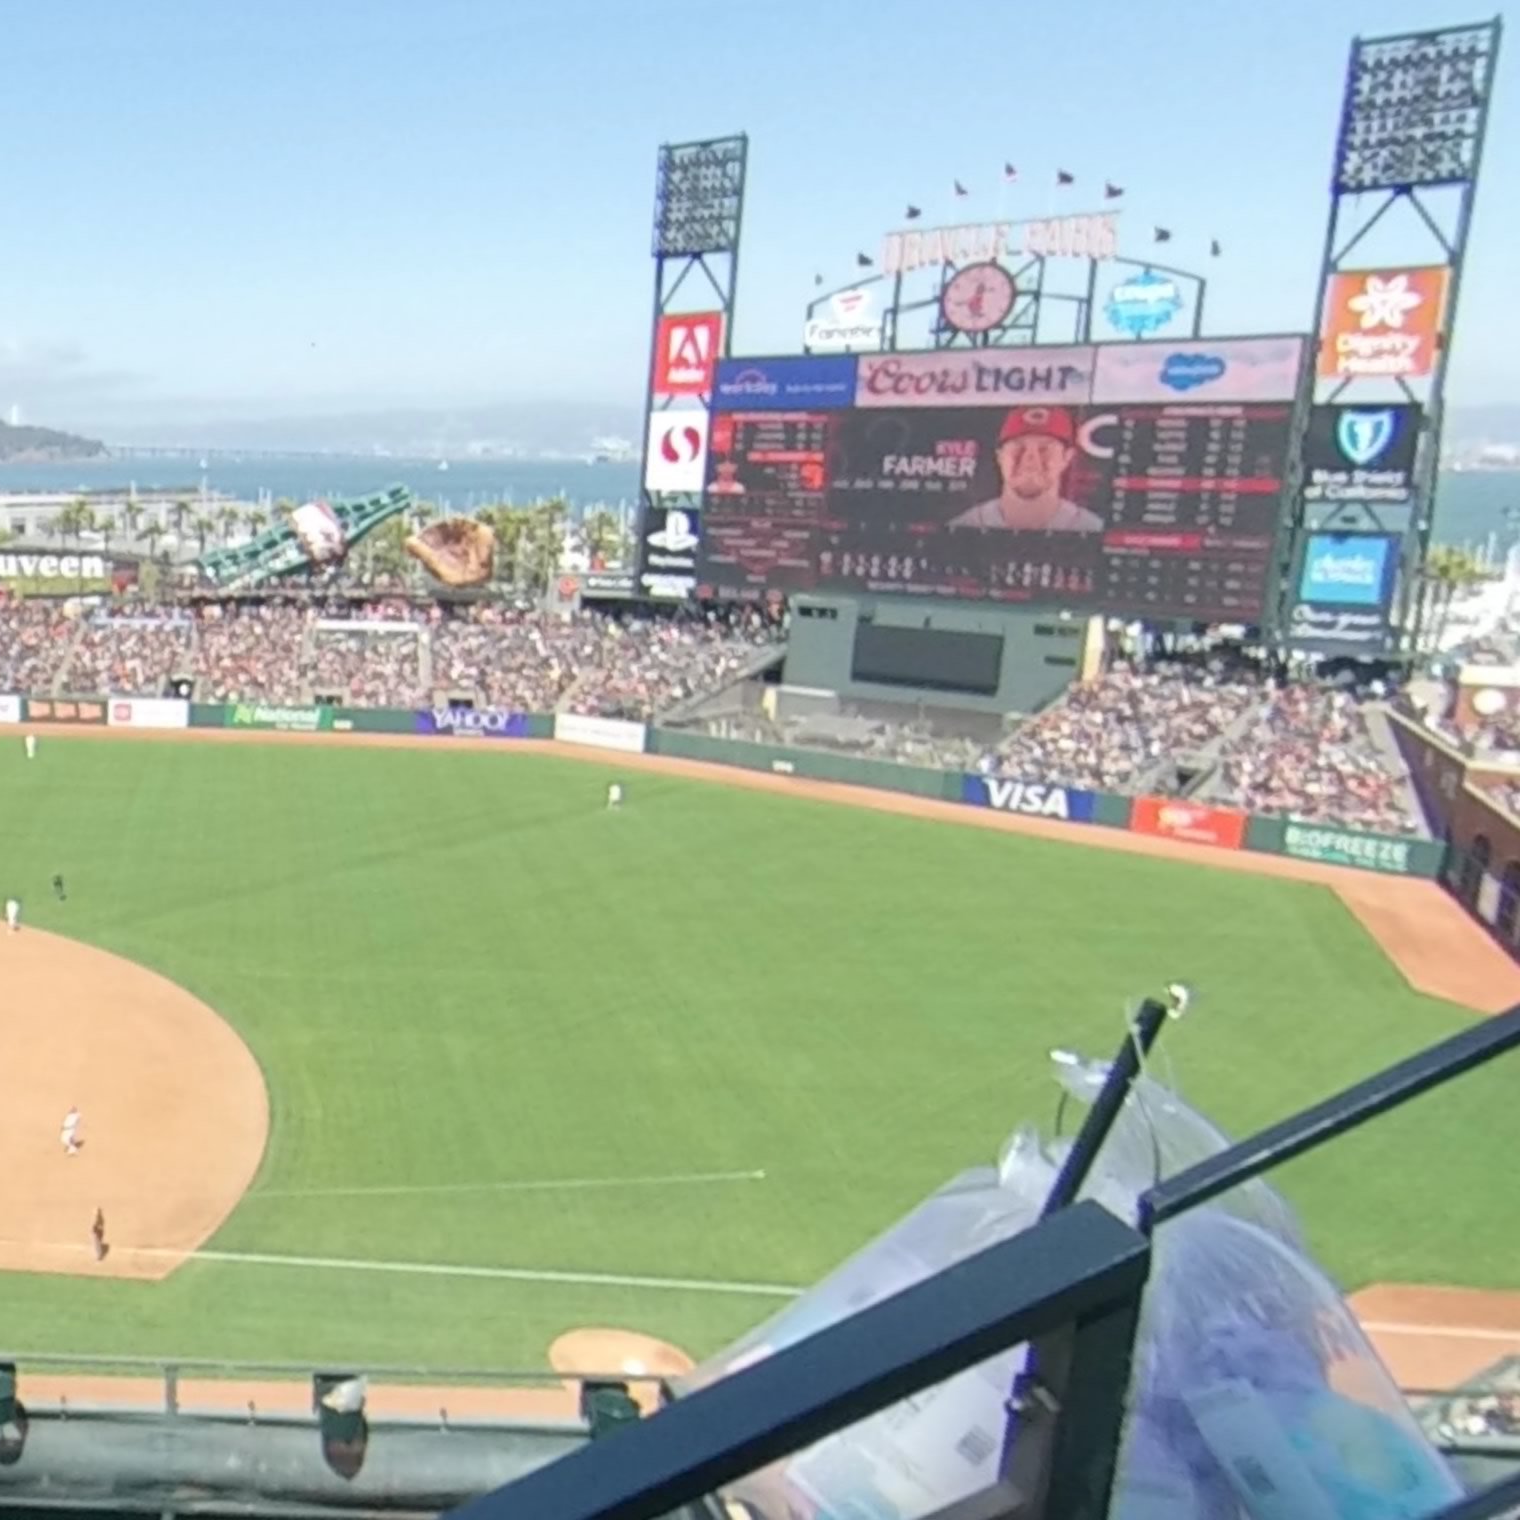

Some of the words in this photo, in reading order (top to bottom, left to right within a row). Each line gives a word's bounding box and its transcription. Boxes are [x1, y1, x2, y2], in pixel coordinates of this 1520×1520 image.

[867, 360, 969, 395] Coors
[974, 362, 1076, 393] LIGHT
[935, 440, 976, 457] KYLE
[883, 456, 977, 478] FARMER
[982, 778, 1068, 818] VISA
[1285, 826, 1408, 863] BIOFREEZE
